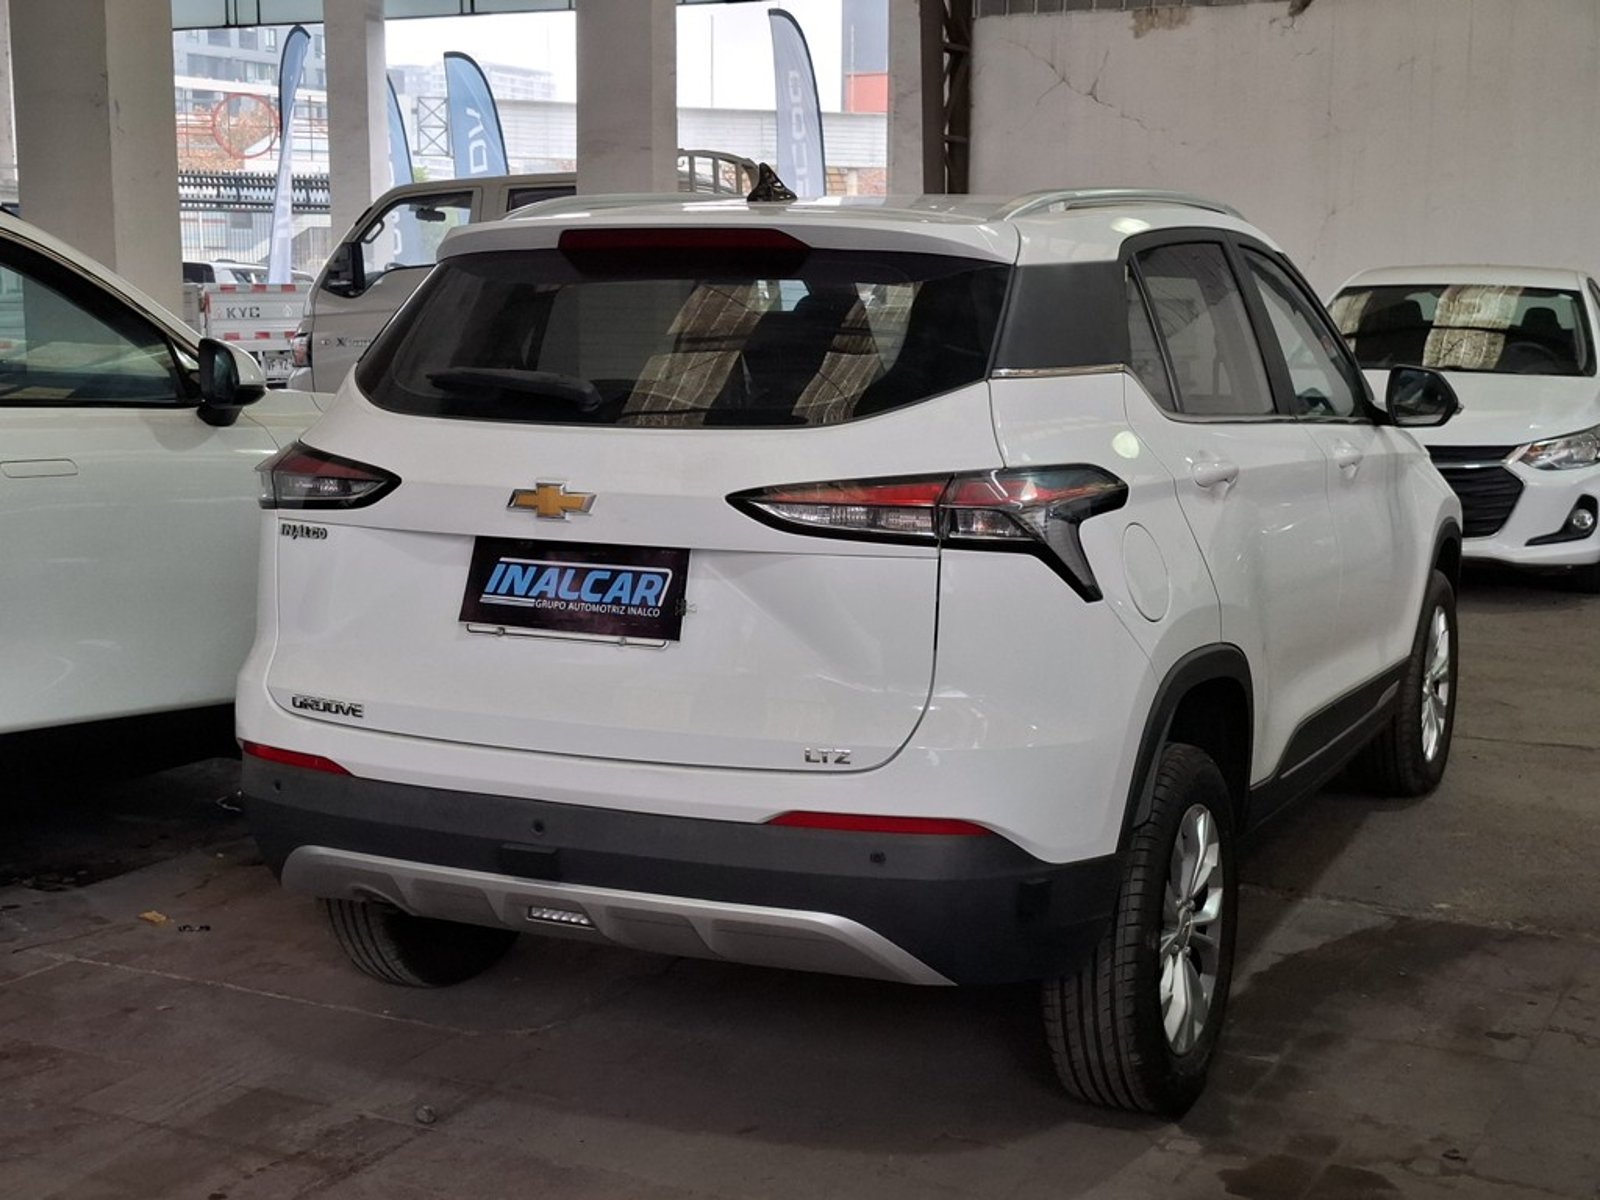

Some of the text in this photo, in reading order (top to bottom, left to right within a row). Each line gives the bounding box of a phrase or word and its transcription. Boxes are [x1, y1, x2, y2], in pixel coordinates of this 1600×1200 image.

[484, 563, 664, 606] INALCAR
[535, 600, 660, 618] GRUPO AUTOMOTRIZ INALCO
[292, 694, 363, 718] GROOVE
[805, 747, 851, 765] LTZ
